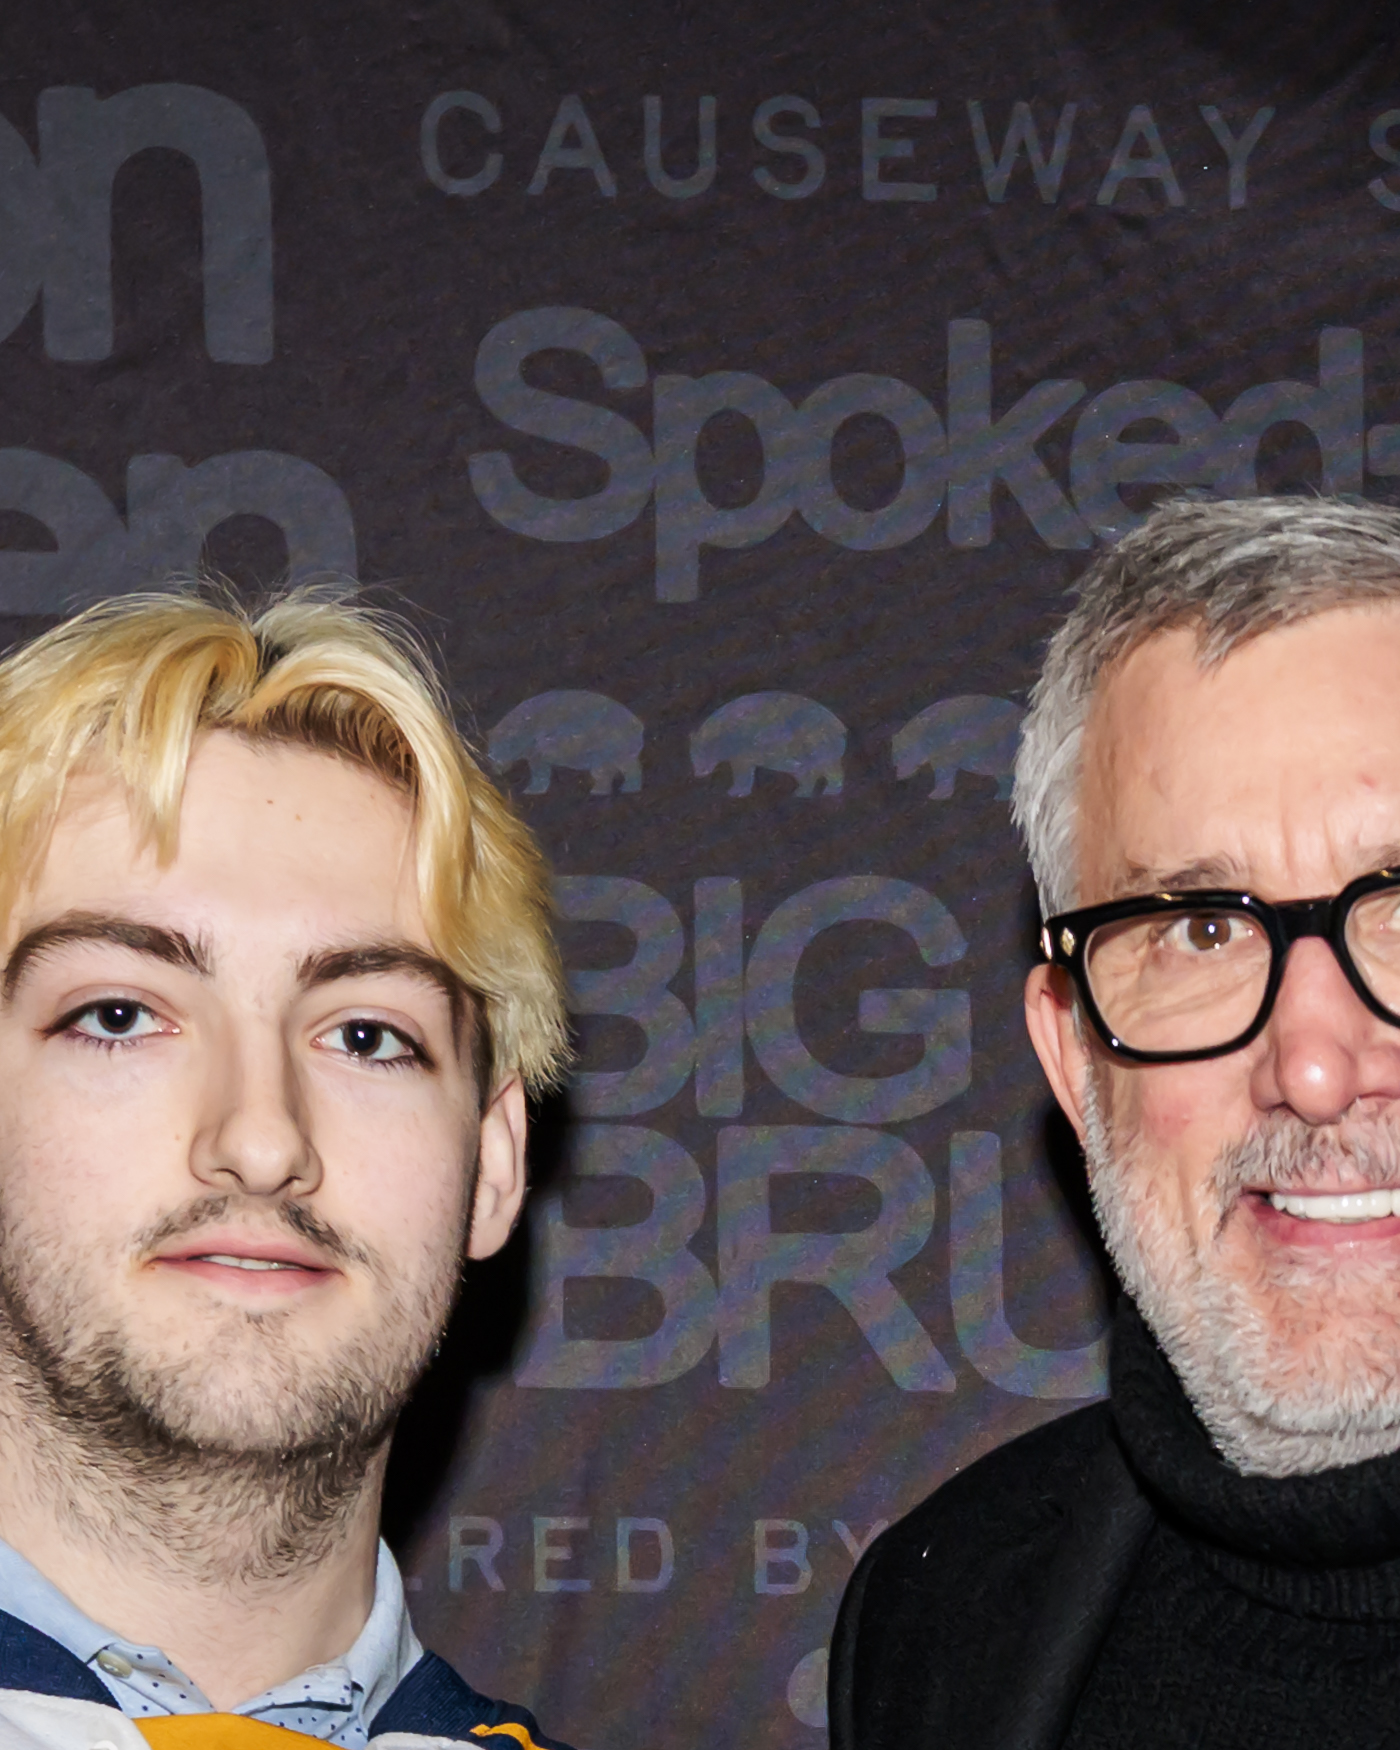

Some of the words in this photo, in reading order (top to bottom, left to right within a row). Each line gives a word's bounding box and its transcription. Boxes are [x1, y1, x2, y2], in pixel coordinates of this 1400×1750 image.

[419, 90, 1276, 210] CAUSEWAY
[554, 874, 973, 1124] BIG
[408, 1515, 675, 1593] RED
